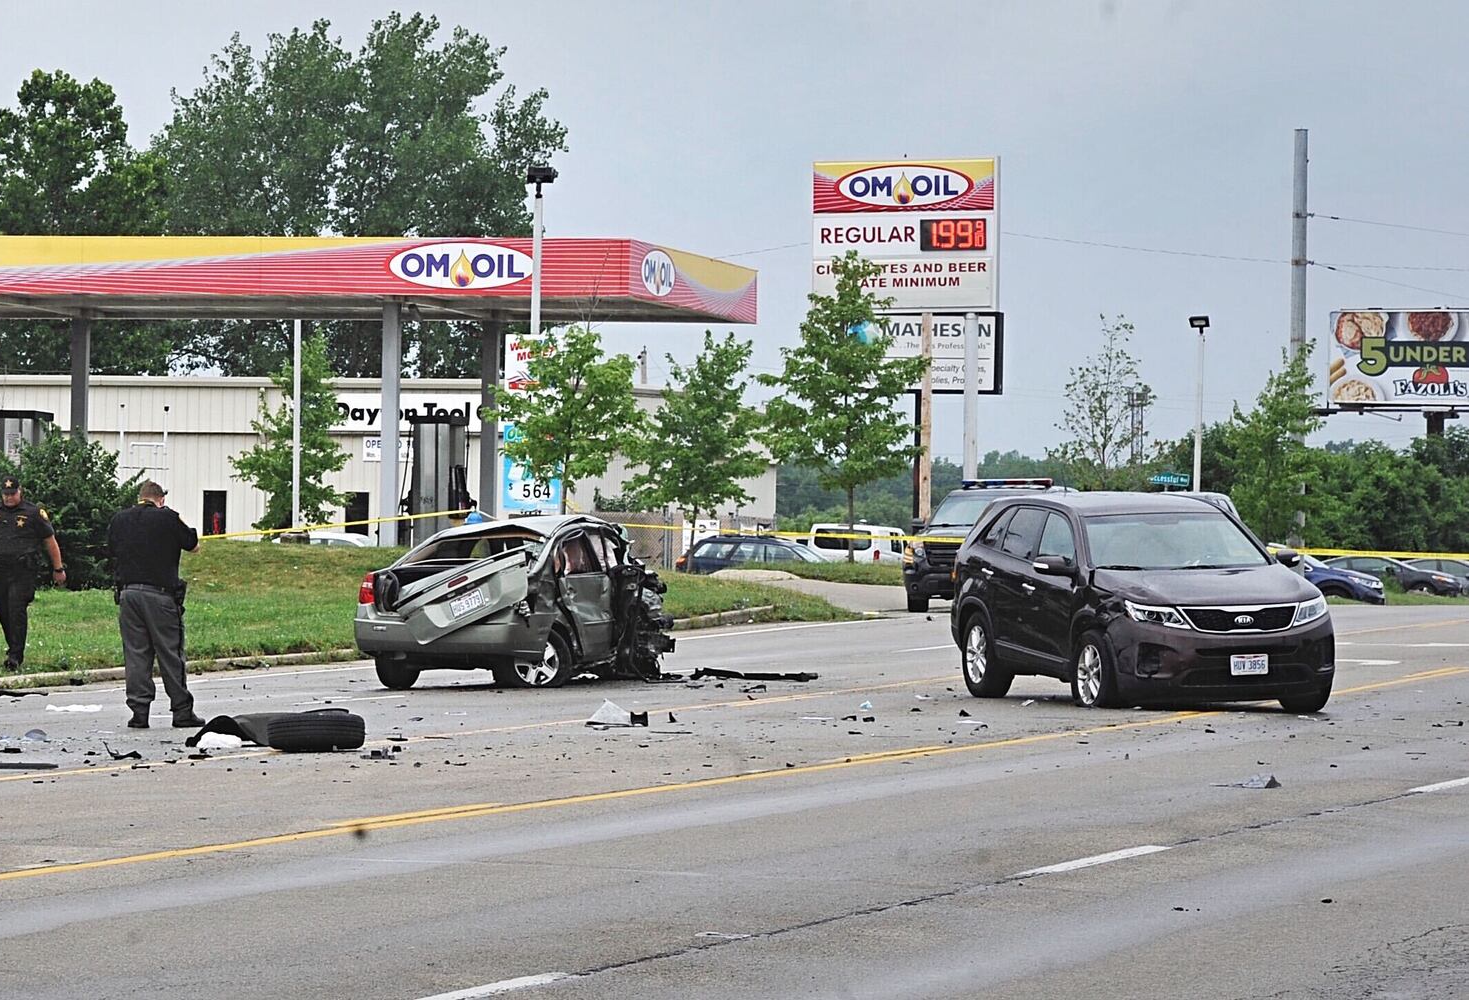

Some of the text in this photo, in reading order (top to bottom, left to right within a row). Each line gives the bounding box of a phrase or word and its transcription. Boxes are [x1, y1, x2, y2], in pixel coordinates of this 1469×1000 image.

[849, 175, 959, 197] OM OIL
[820, 226, 916, 244] REGULAR
[931, 220, 972, 249] 1.99
[401, 253, 525, 278] OM OIL
[644, 258, 672, 288] OM OIL
[913, 263, 943, 273] AND
[948, 262, 987, 273] BEER
[892, 277, 960, 288] MINIMUM
[1356, 336, 1467, 376] 5 UNDER
[423, 401, 470, 420] Tool
